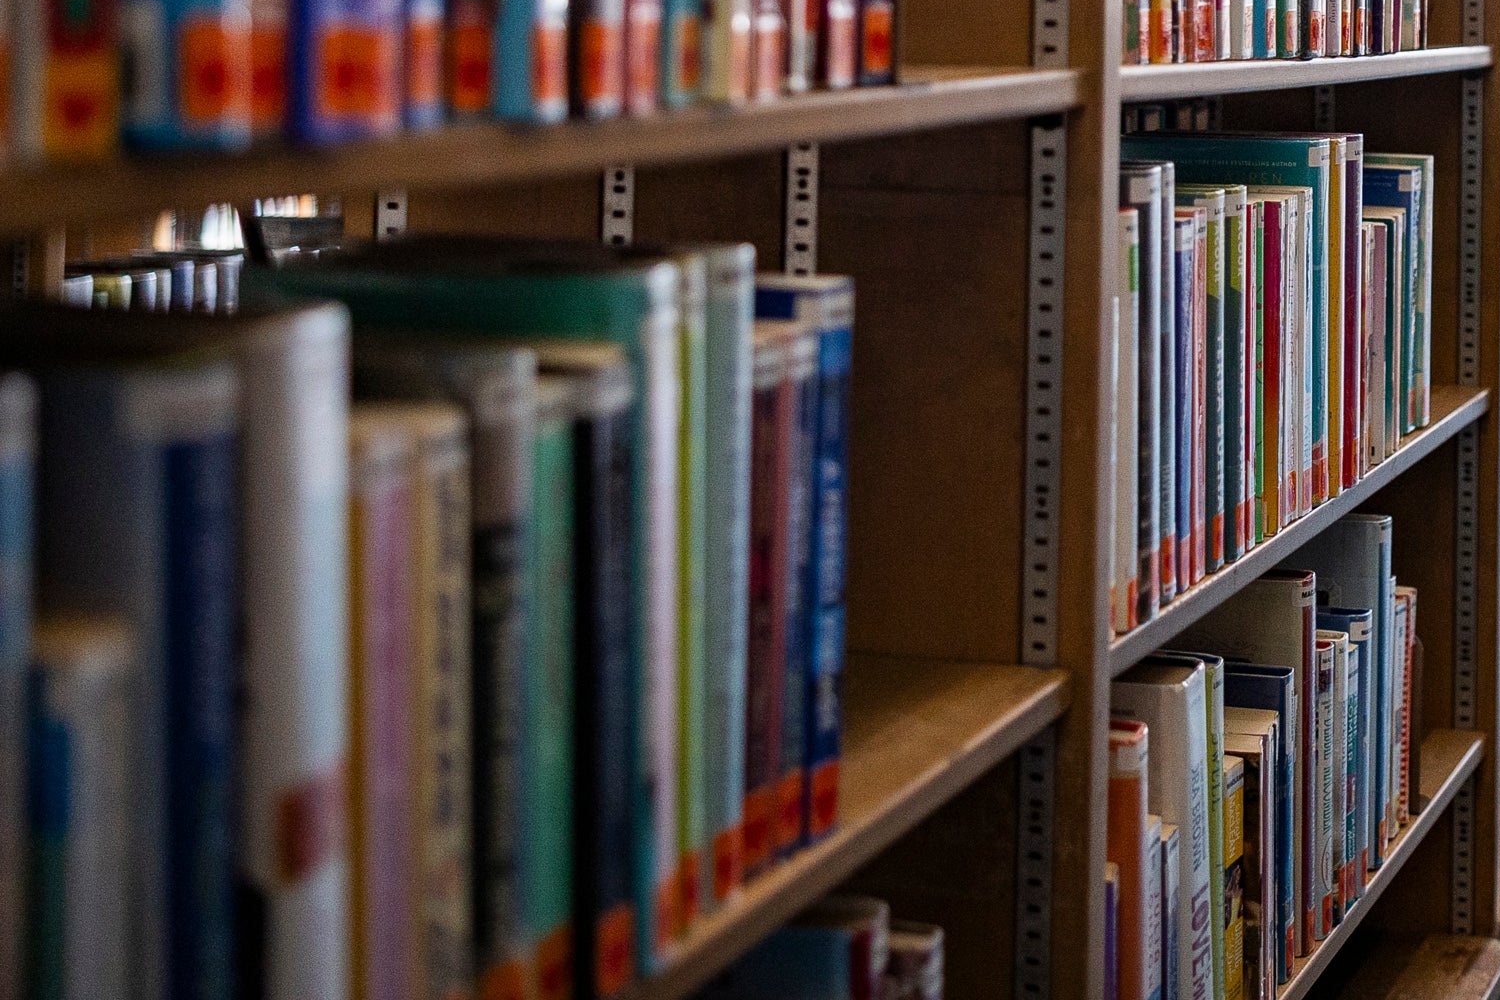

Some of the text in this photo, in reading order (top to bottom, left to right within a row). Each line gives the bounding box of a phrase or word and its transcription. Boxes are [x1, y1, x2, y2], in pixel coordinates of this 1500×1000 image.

[1192, 802, 1203, 874] BROWN
[1191, 881, 1211, 978] LOVE
[1234, 922, 1243, 968] DARING
